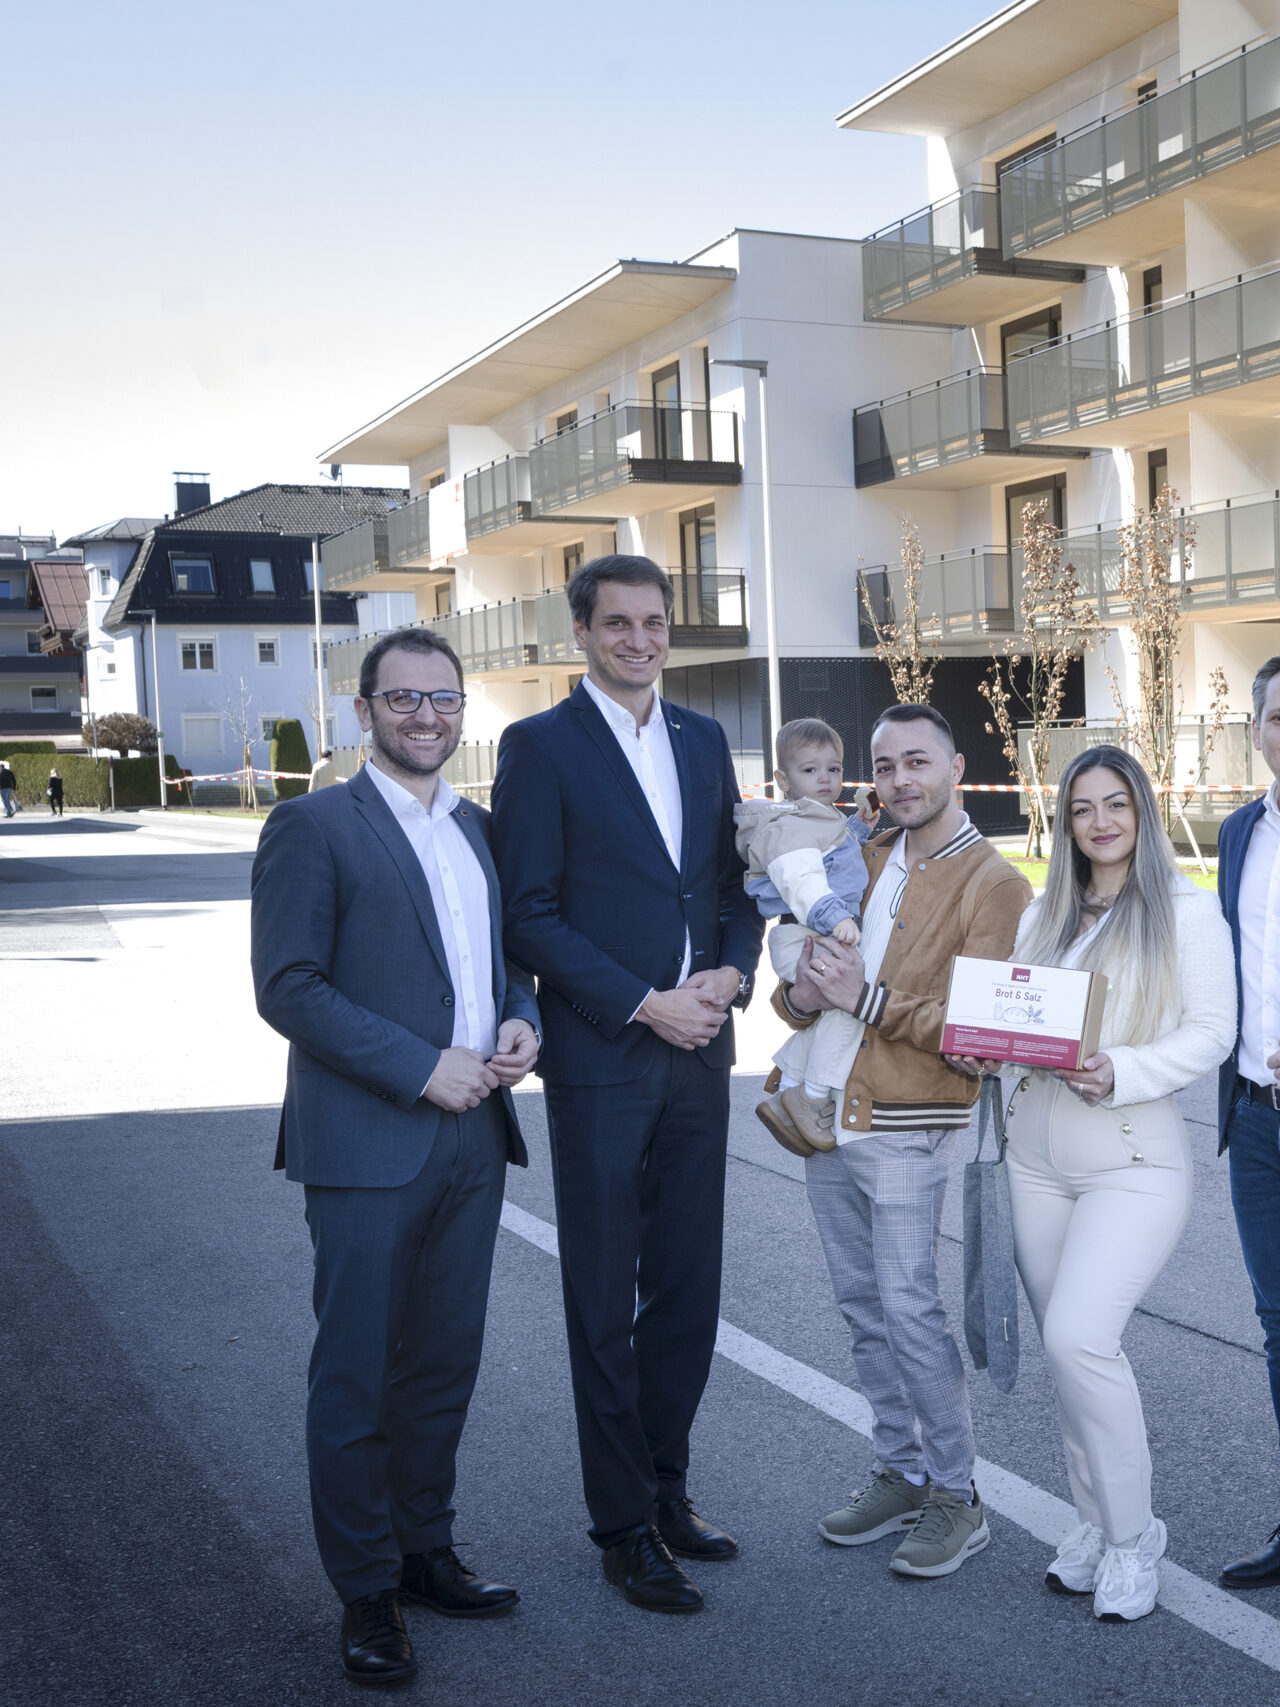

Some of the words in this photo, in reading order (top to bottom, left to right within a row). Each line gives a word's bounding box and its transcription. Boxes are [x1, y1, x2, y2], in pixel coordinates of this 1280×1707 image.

[995, 988, 1013, 998] Brot
[1015, 990, 1021, 1000] &
[1023, 991, 1042, 1002] Salz
